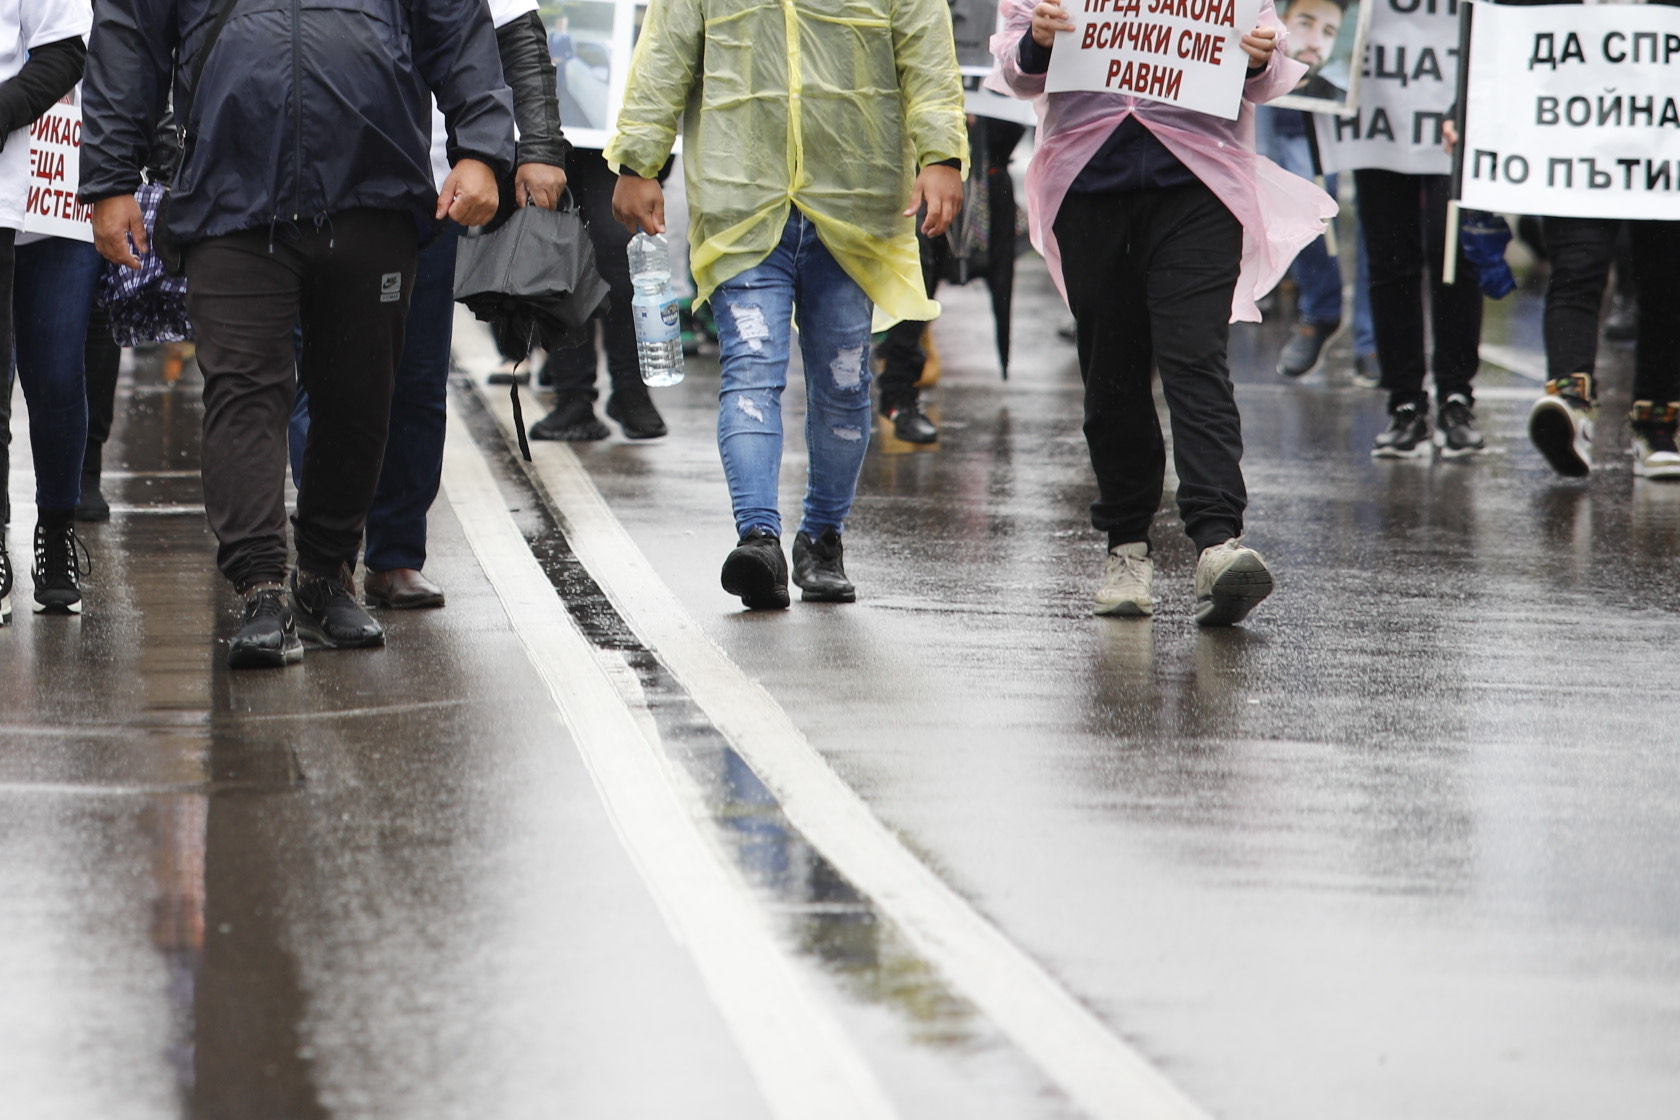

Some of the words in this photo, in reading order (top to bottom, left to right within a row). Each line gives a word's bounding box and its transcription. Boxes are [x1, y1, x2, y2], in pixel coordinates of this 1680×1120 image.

[1081, 21, 1172, 55] ВСИЧКИ
[1177, 29, 1225, 66] СМЕ
[1528, 32, 1586, 71] ДА
[1105, 59, 1183, 101] РАВНИ
[1363, 44, 1460, 87] ЦА
[1334, 107, 1395, 142] НА
[1535, 87, 1680, 128] ВОЙНА
[1473, 149, 1530, 185] ПО
[1546, 157, 1680, 191] ПЪТИ
